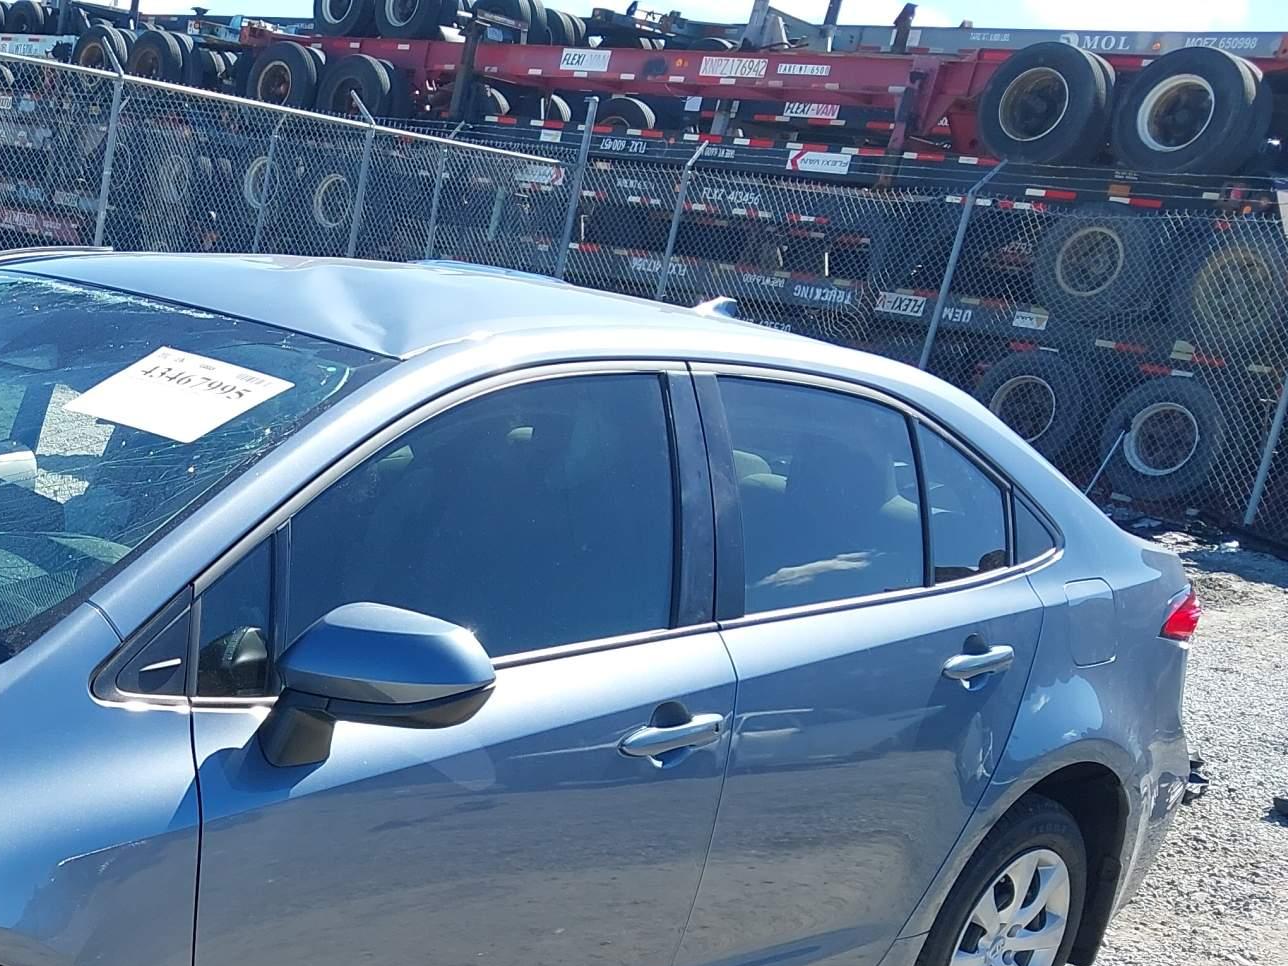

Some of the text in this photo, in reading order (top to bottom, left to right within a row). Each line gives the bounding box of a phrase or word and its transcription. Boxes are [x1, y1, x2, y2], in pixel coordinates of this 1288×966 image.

[1082, 35, 1131, 50] MOL
[1218, 37, 1258, 50] 650998
[140, 364, 252, 400] 43467995
